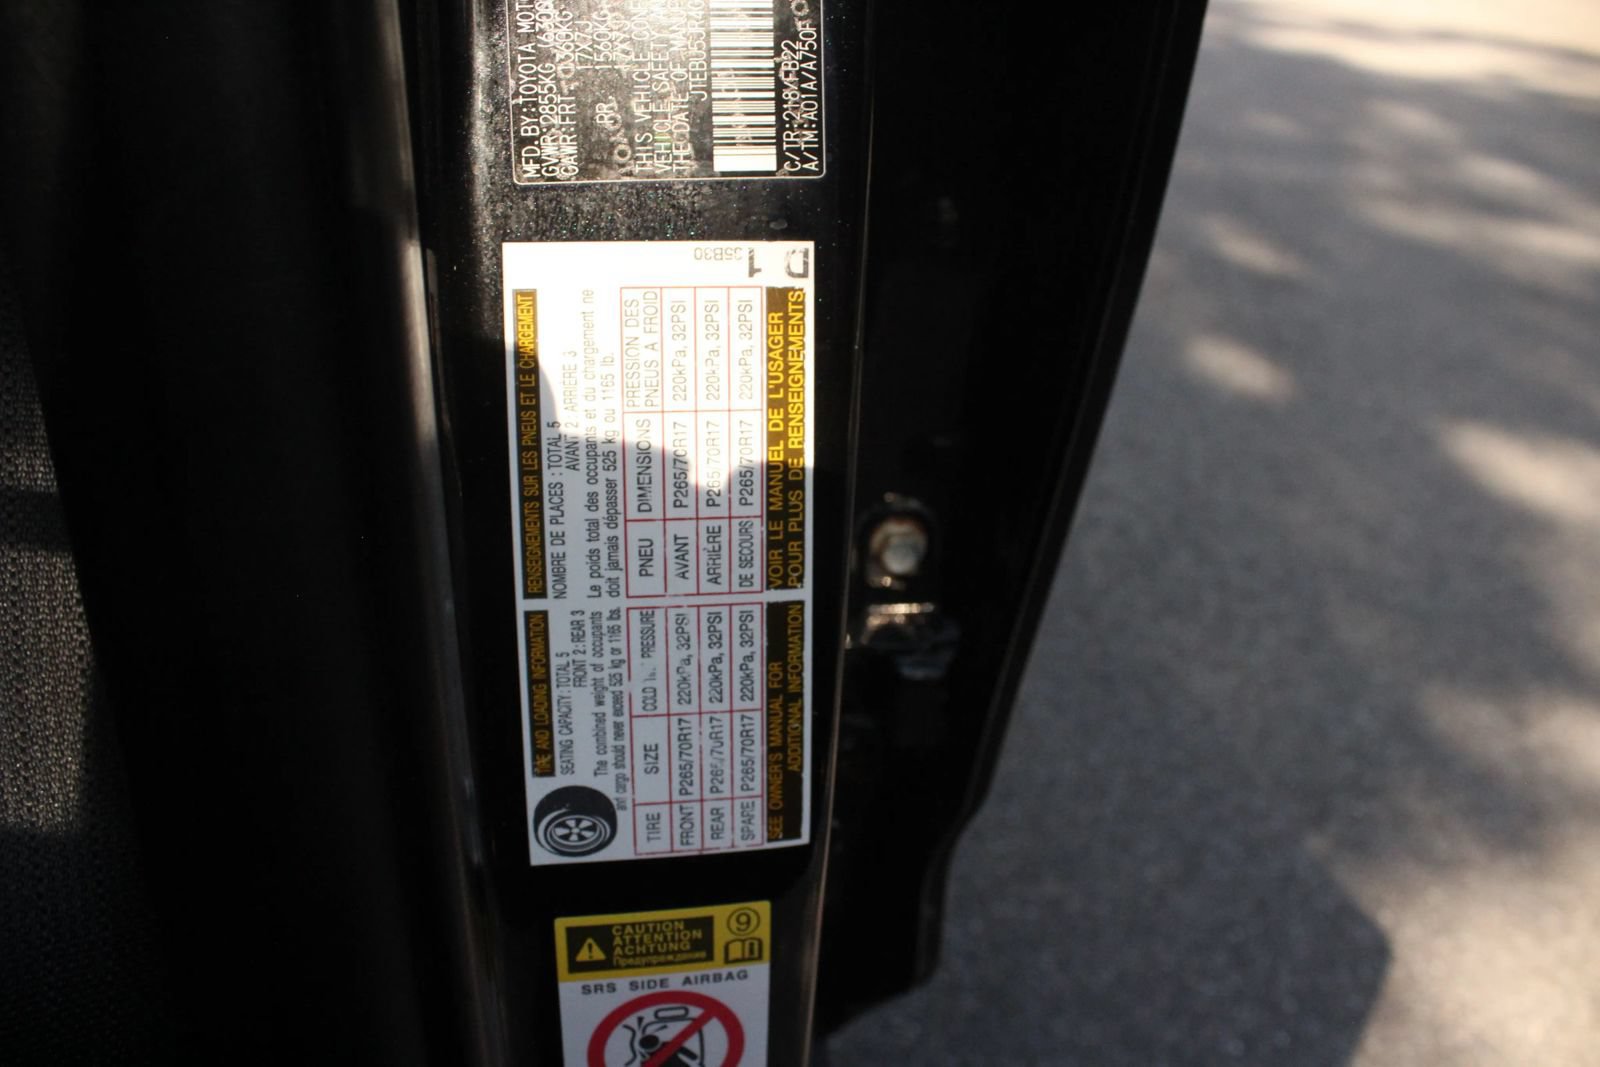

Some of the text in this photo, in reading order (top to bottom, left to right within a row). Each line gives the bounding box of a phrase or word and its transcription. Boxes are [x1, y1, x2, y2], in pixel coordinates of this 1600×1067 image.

[515, 0, 536, 32] MOT
[650, 30, 669, 91] SAFETY
[670, 61, 688, 82] OF
[632, 52, 652, 122] VEHICLE
[670, 92, 690, 132] DATE
[634, 132, 653, 173] THIS
[652, 102, 673, 173] VEHICLE
[673, 143, 691, 172] THE
[643, 291, 658, 334] FROID
[624, 299, 640, 408] PRESSION DES
[671, 300, 688, 401] 220kPa, 32PSI
[705, 300, 721, 400] 220kPa, 32PSI
[738, 300, 754, 400] 220kPa, 32PSI
[558, 364, 578, 412] ARRIÈRE
[601, 373, 615, 400] 1165
[644, 359, 659, 407] PNEUS
[603, 409, 615, 423] ou
[517, 295, 542, 593] RENSEIGNEMENTS SUR LES PNEUS ET LE CHARGEMENT
[547, 433, 562, 470] TOTAL
[564, 435, 580, 471] AVANT
[581, 290, 604, 598] Le poids total des occupants et du chargement ne
[601, 430, 619, 444] kg
[768, 312, 784, 587] VOIR LE MANUEL DE L'USAGER
[788, 291, 804, 586] POUR PLUS DE RENSEIGNEMENTS
[602, 451, 617, 472] 525
[635, 419, 652, 512] DIMENSIONS
[672, 422, 689, 508] P265/70R17
[739, 420, 754, 506] P265/70R17
[548, 482, 564, 525] PLACES
[602, 478, 622, 529] dépasser
[550, 531, 565, 546] DE
[603, 535, 623, 571] jamais
[638, 538, 654, 577] PNEU
[674, 534, 689, 580] AVANT
[702, 526, 722, 586] ARRIÈRE
[738, 521, 754, 587] DE SECOURS
[550, 552, 567, 599] NOMBRE
[604, 577, 620, 598] doit
[528, 614, 547, 680] INFORMATION
[608, 625, 622, 643] 1165
[610, 647, 622, 655] or
[640, 610, 656, 659] PRESSURE
[675, 613, 691, 650] 32PSI
[556, 661, 571, 688] TOTAL
[572, 659, 587, 687] FRONT
[608, 659, 626, 669] kg
[707, 612, 724, 703] 220kPa, 32PSI
[739, 610, 756, 702] 220kPa, 32PSI
[589, 611, 608, 777] The combined weight of occupants
[609, 673, 623, 686] 525
[641, 686, 657, 712] COLD
[787, 604, 802, 772] ADDITIONAL INFORMATION
[532, 684, 549, 726] LOADING
[610, 690, 624, 717] exceed
[534, 730, 550, 750] AND
[612, 721, 625, 741] never
[768, 661, 782, 839] SEE OWNER'S MANUAL FOR
[560, 739, 575, 775] SEATING
[612, 745, 626, 769] should
[644, 743, 659, 775] SIZE
[677, 718, 694, 796] P265/70R17
[740, 714, 756, 792] P265/70R17
[614, 773, 630, 794] cargo
[614, 798, 627, 810] and
[710, 807, 725, 840] REAR
[740, 800, 756, 841] SPARE
[646, 813, 661, 842] TIRE
[678, 805, 694, 846] FRONT
[612, 920, 685, 936] CAUTION
[613, 929, 702, 946] ATTENTION
[736, 912, 751, 932] 9
[613, 940, 691, 956] ACHTUNG
[581, 969, 748, 995] SRS SIDE AIRBAG
